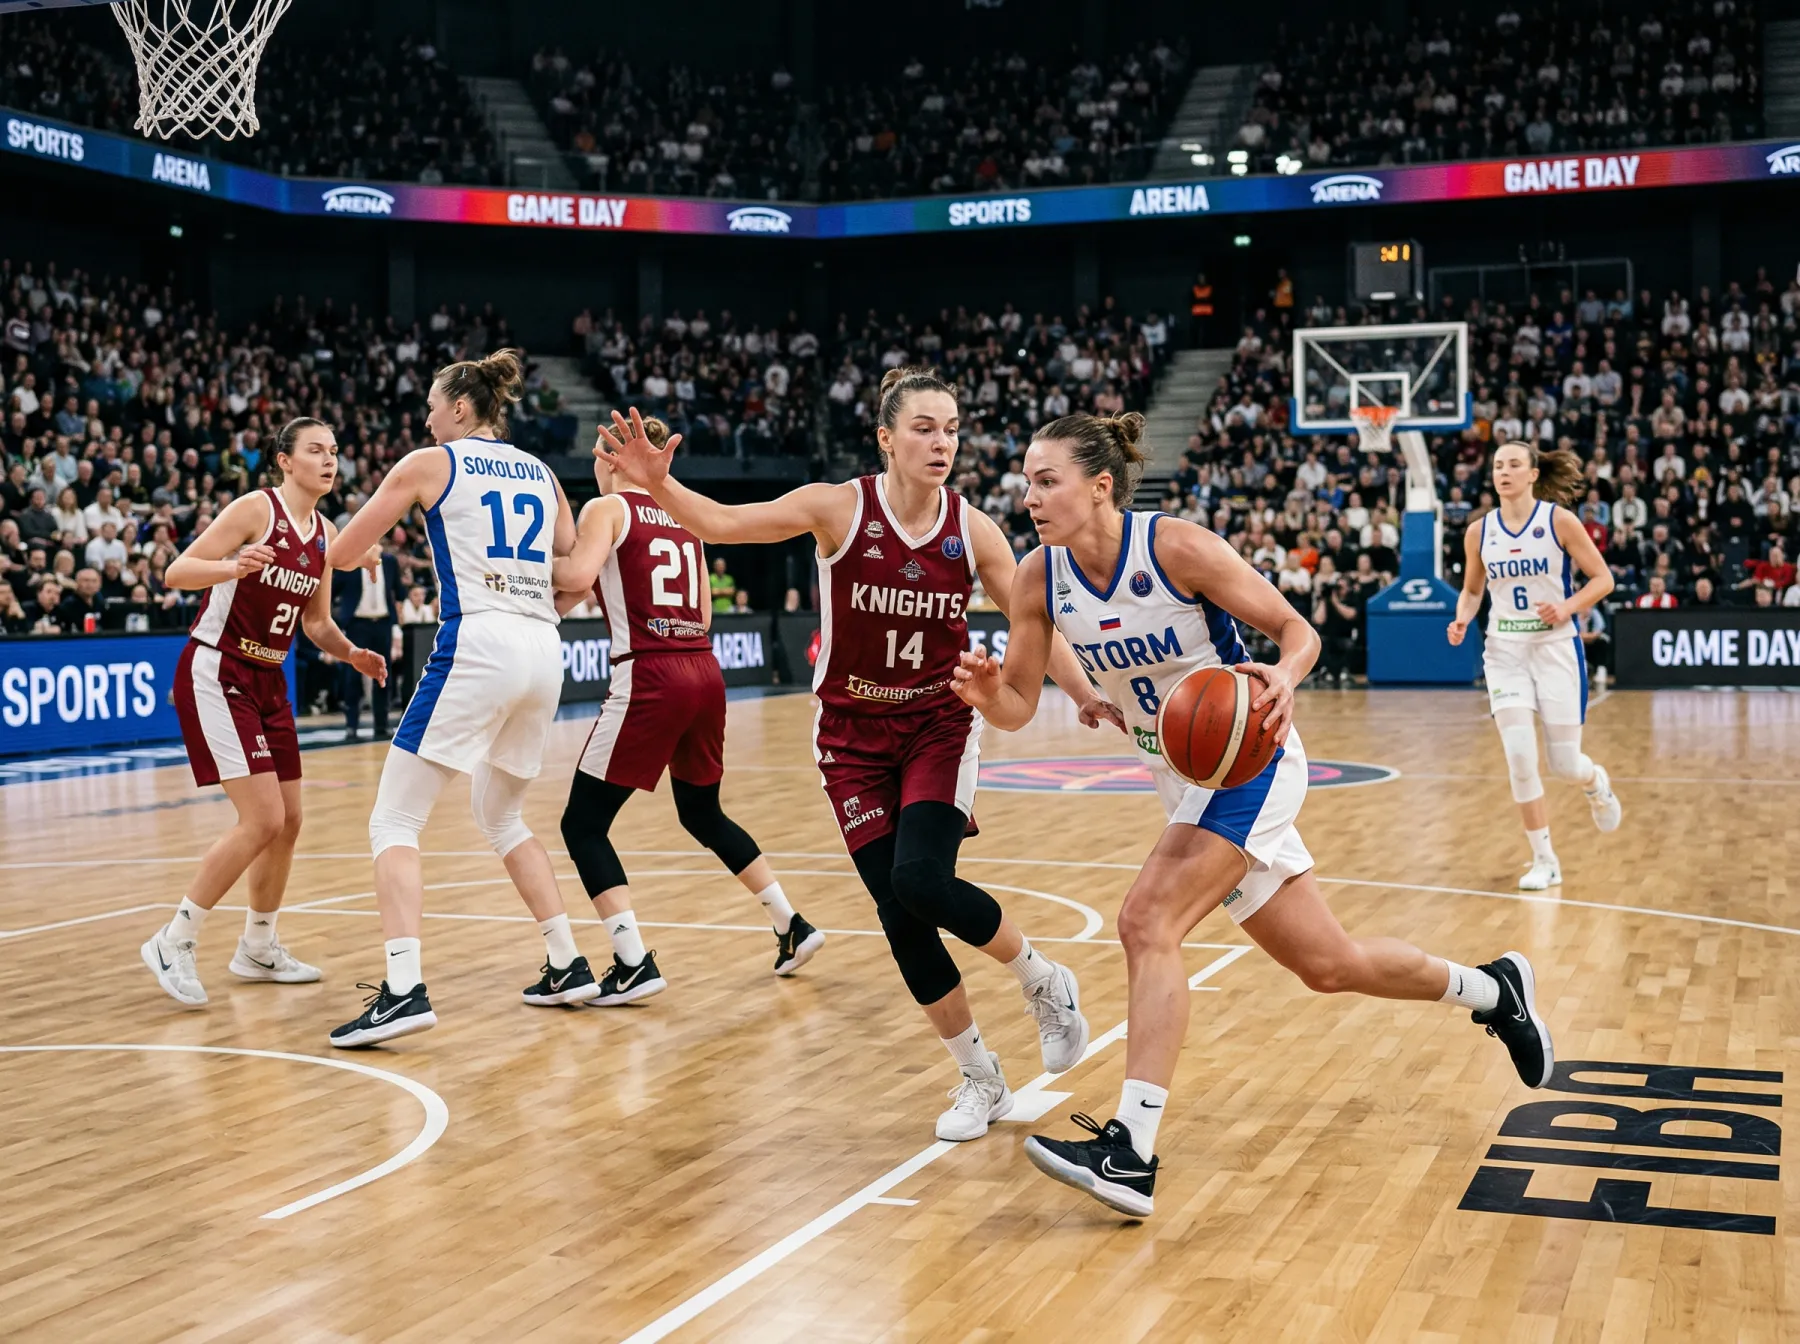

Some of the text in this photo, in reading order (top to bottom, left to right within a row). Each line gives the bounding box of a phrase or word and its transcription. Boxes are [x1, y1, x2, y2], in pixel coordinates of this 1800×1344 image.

[7, 119, 84, 162] SPORTS
[152, 152, 211, 192] ARENA
[1504, 155, 1641, 194] GAME DAY
[324, 194, 392, 215] ARENA
[507, 194, 627, 228] GAME DAY
[948, 198, 1032, 226] SPORTS
[1129, 184, 1210, 216] ARENA
[1312, 182, 1381, 204] ARENA
[730, 214, 790, 234] ARENA
[463, 456, 545, 483] SOKOLOVA
[480, 490, 546, 563] 12
[635, 505, 684, 529] KOVAL
[649, 537, 699, 609] 21
[1487, 557, 1549, 580] STORM
[850, 582, 964, 620] KNIGHTS
[1512, 586, 1529, 611] 6
[269, 602, 301, 637] 21
[711, 631, 765, 670] ARENA
[885, 629, 924, 670] 14
[1071, 626, 1184, 673] STORM
[1652, 629, 1800, 667] GAME DAY
[2, 661, 156, 727] SPORTS
[1129, 676, 1162, 716] 8
[1456, 1060, 1784, 1235] FIBA
